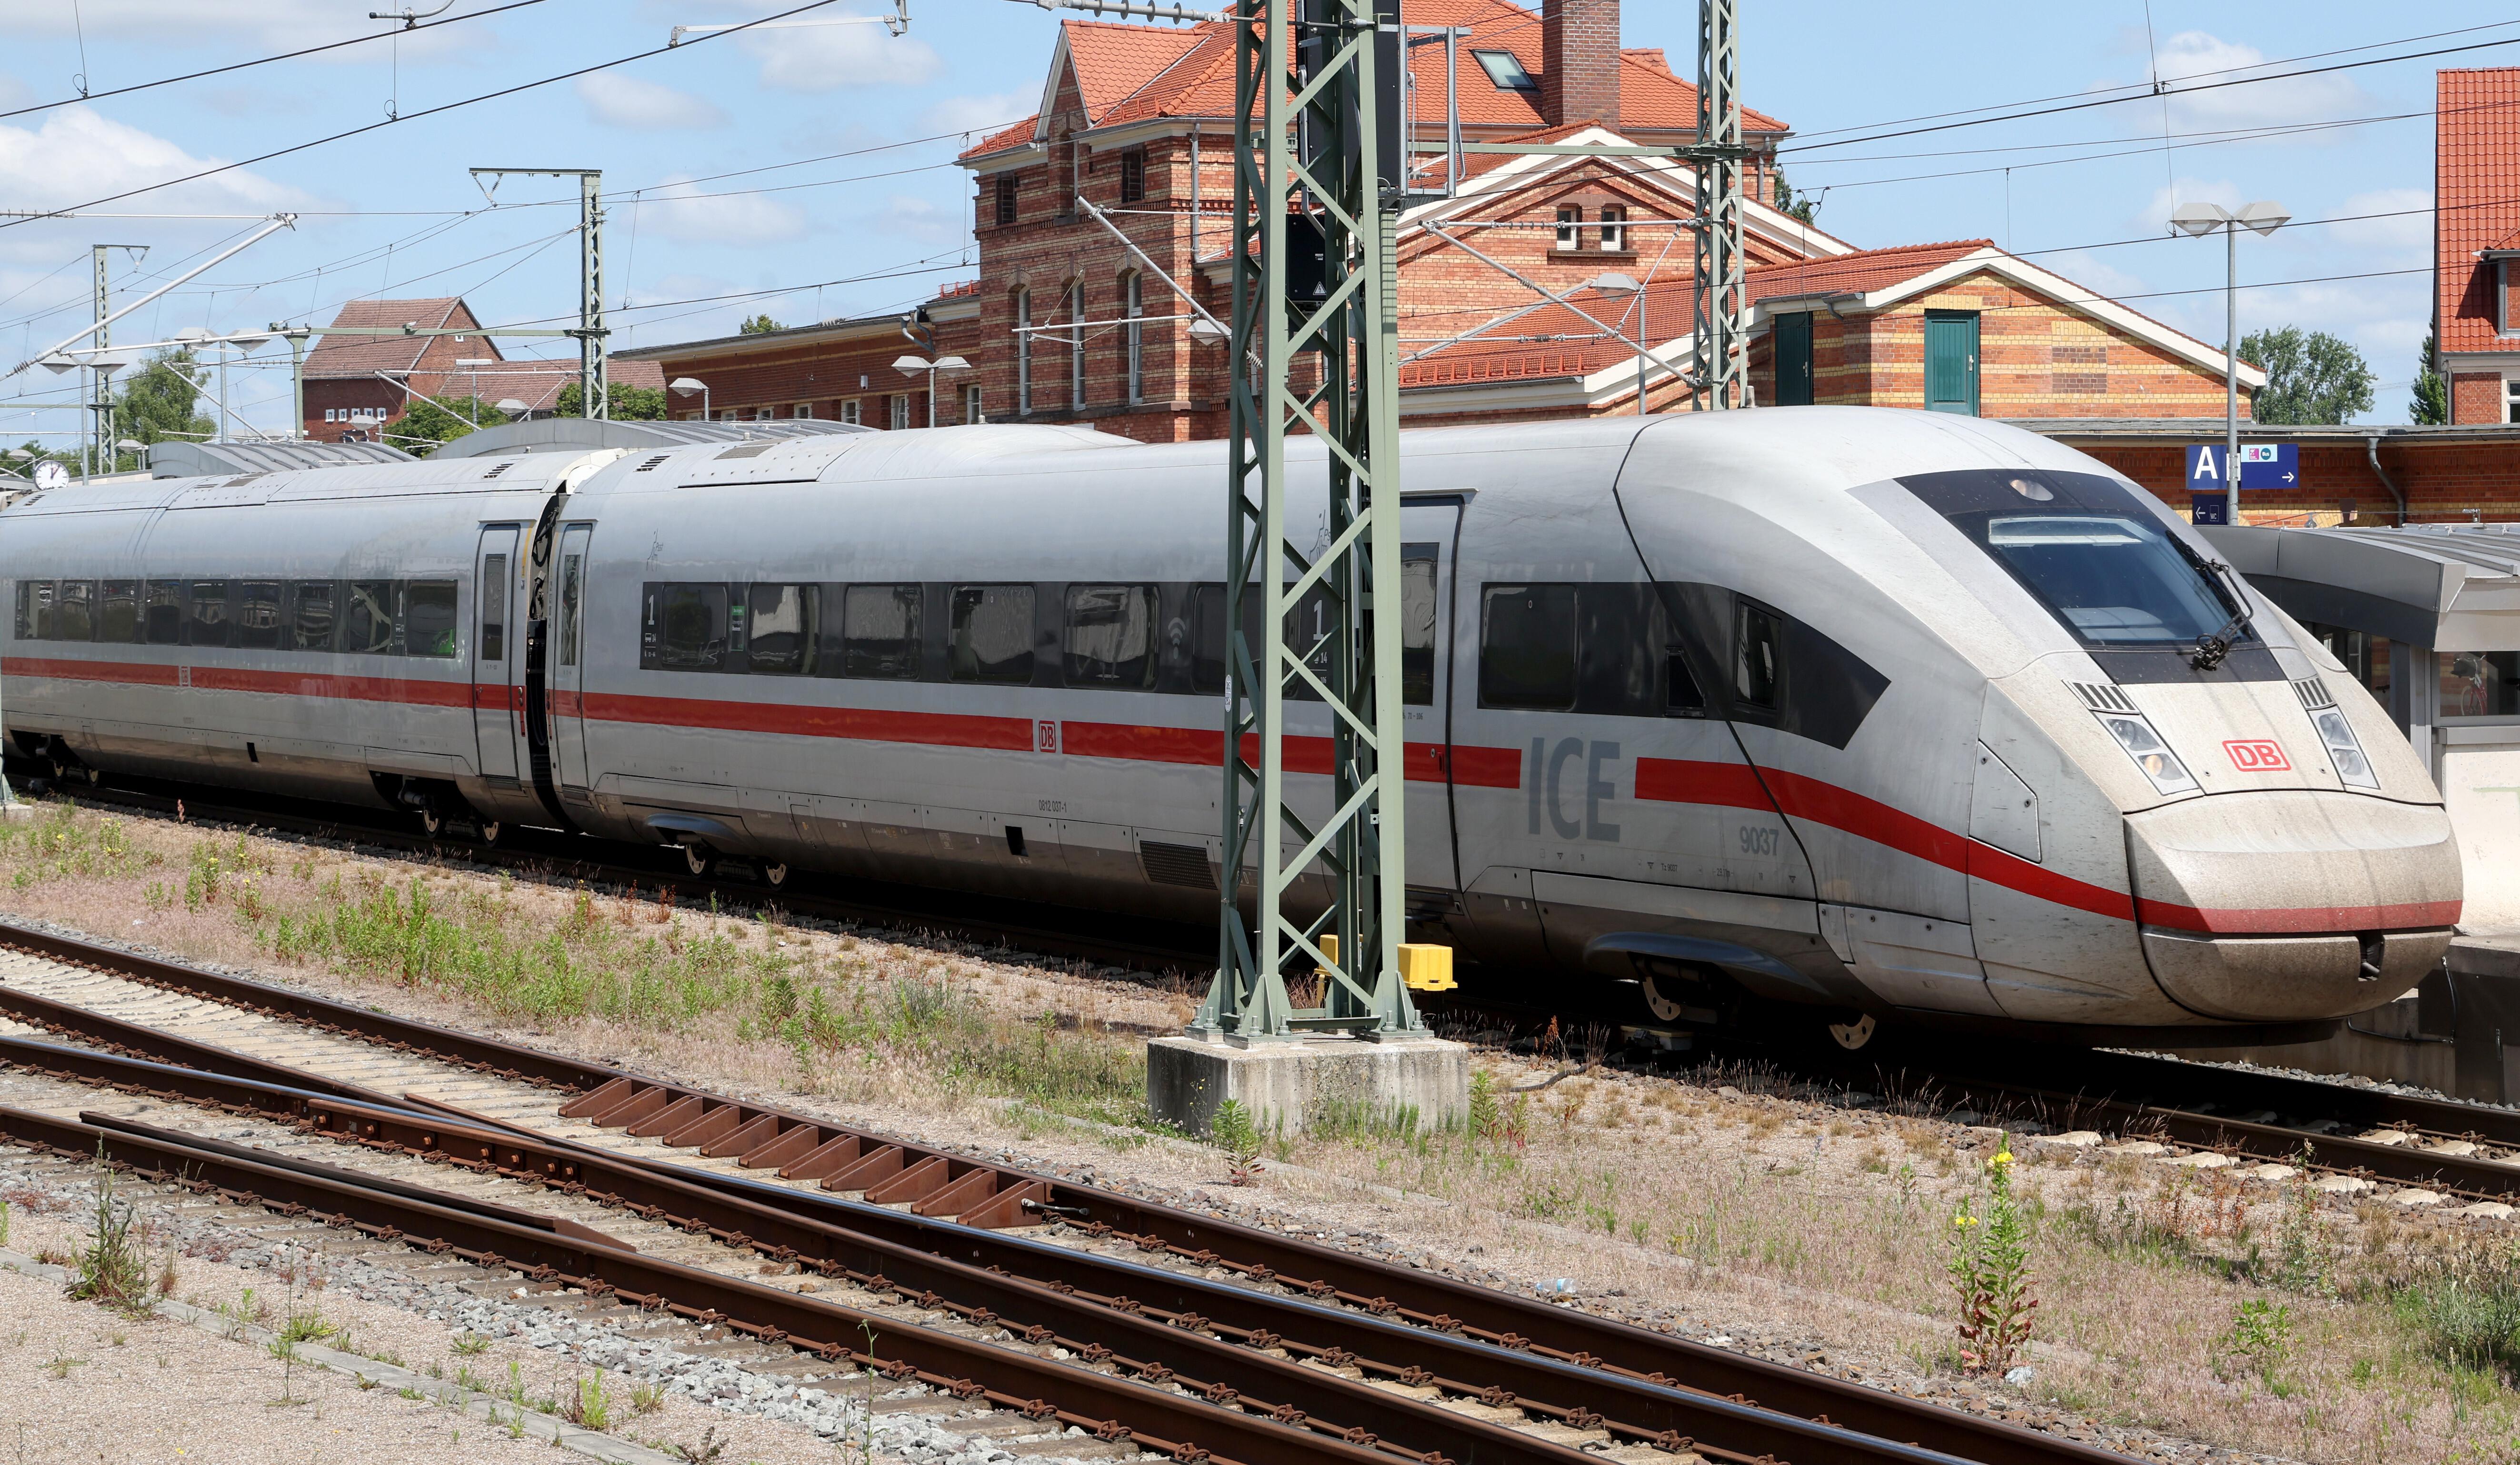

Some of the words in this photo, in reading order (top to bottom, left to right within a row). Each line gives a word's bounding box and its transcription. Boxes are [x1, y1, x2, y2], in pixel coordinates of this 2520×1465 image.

[2194, 446, 2218, 480] A
[398, 591, 403, 617] 1
[648, 595, 655, 625] 1
[1313, 600, 1324, 641] 1
[1320, 652, 1327, 663] 14
[1040, 725, 1054, 749] DB
[2231, 743, 2282, 767] DB
[1529, 736, 1620, 843] ICE
[1039, 799, 1051, 812] 0812
[1051, 801, 1067, 813] 037-1
[1740, 825, 1779, 856] 9037
